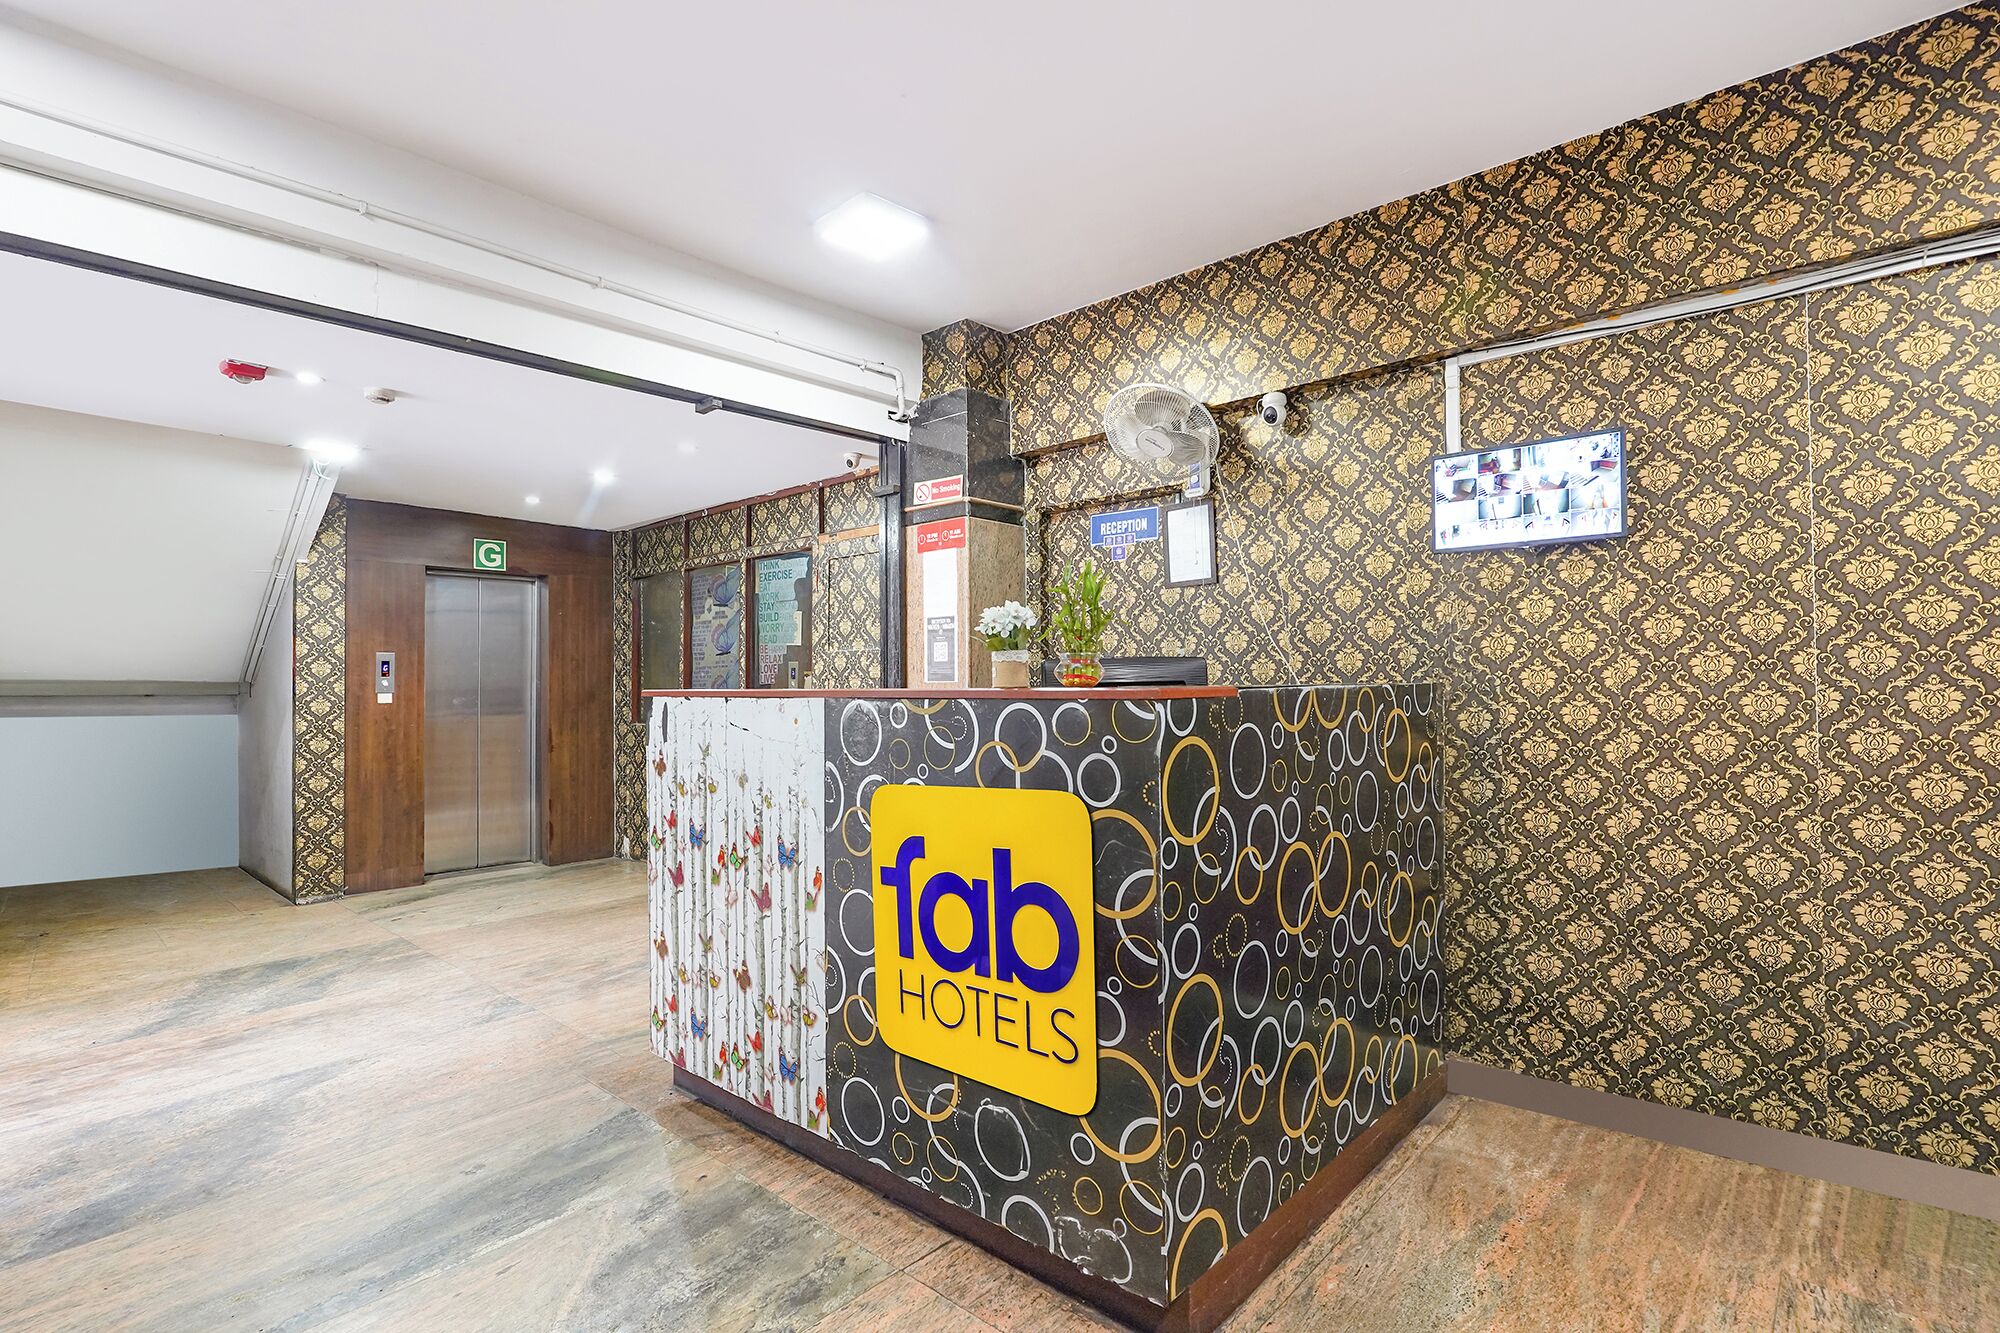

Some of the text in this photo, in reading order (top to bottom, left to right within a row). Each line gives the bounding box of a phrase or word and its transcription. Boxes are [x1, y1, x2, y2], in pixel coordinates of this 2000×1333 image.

[939, 483, 961, 493] Smoking
[1101, 518, 1148, 535] RECEPTION
[478, 543, 502, 568] G
[759, 560, 780, 571] THINK
[759, 569, 793, 583] EXERCISE
[759, 582, 772, 593] EAT
[759, 592, 780, 602] WORK
[759, 602, 775, 612] STAY
[759, 612, 779, 623] BUILD
[759, 622, 784, 633] WORRY
[760, 634, 778, 644] READ
[760, 645, 768, 654] BE
[760, 654, 782, 664] RELAX
[760, 664, 777, 674] LOVE
[760, 674, 775, 684] LIVE
[880, 836, 1080, 993] fab
[899, 969, 1079, 1065] HOTELS
